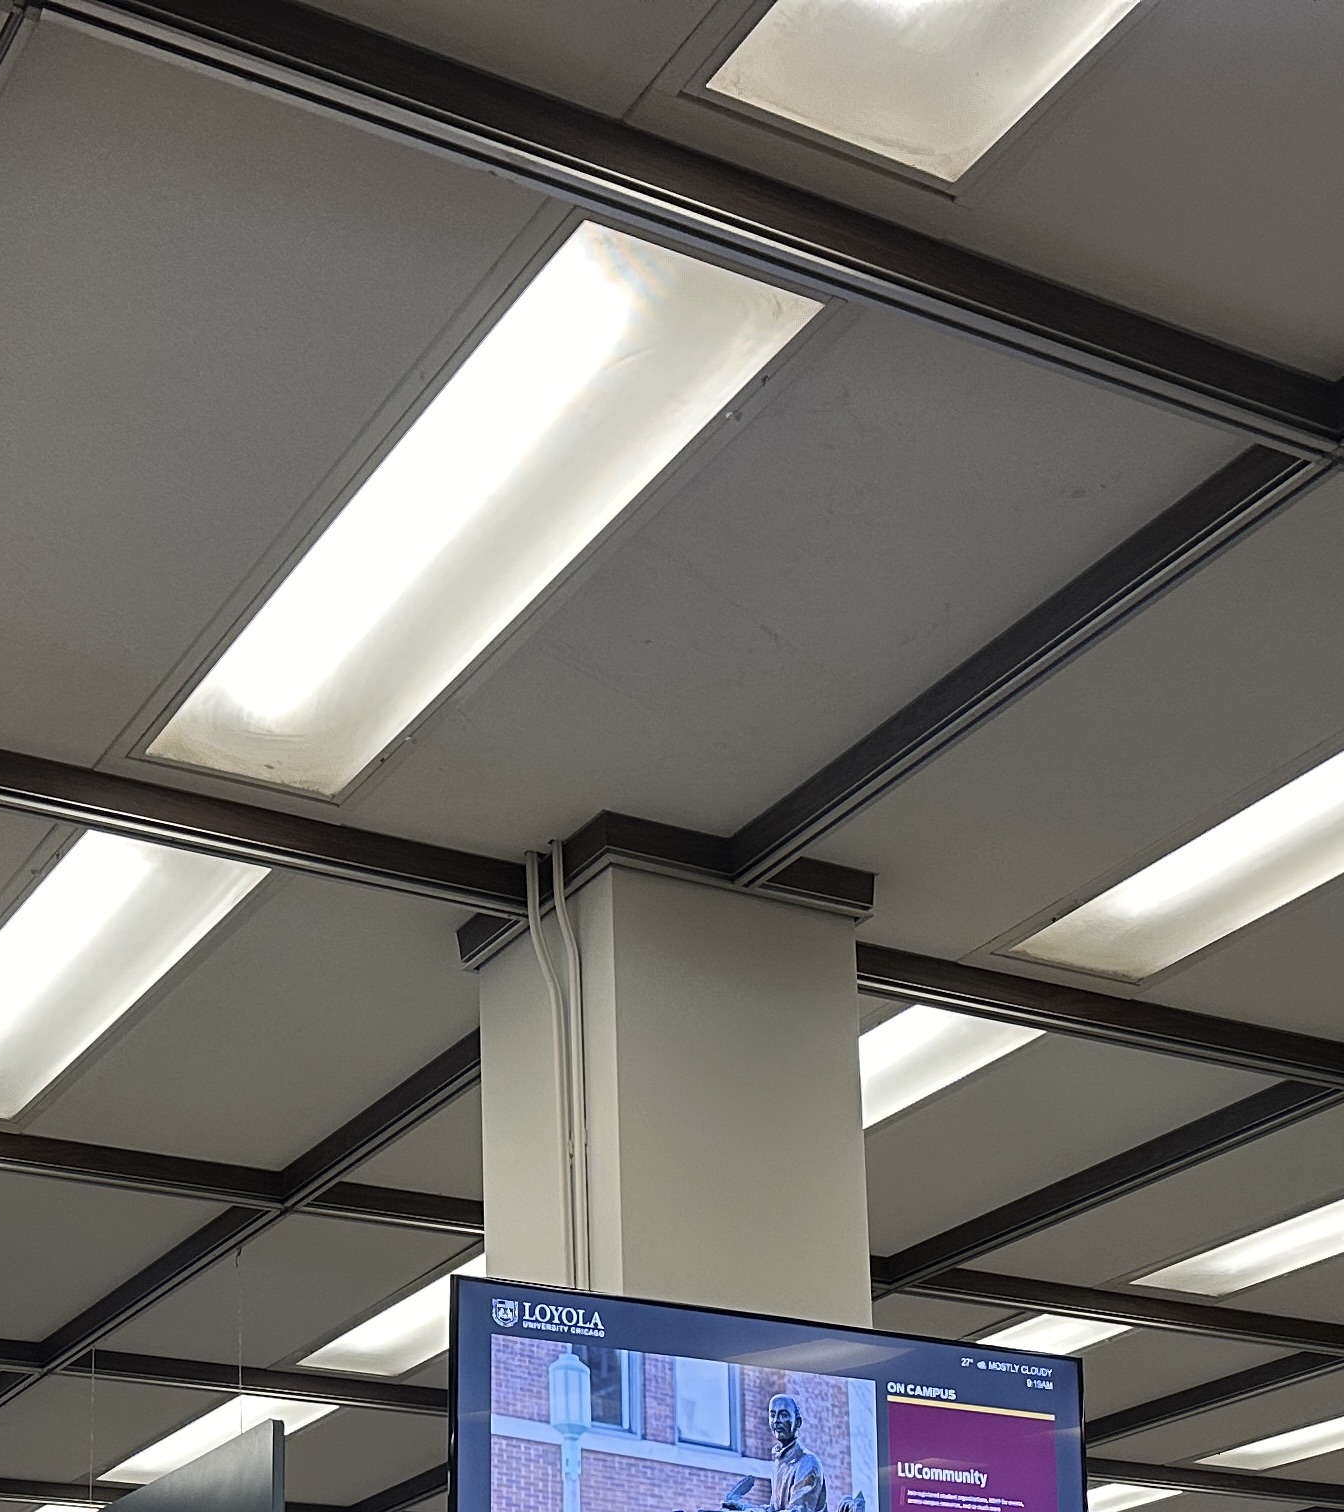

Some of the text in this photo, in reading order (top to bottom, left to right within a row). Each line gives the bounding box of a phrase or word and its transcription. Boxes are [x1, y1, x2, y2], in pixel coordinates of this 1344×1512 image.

[522, 1301, 605, 1330] LOYOLA
[522, 1320, 605, 1338] UNIVERSITY CHICAGO
[988, 1360, 1019, 1373] MOSTLY
[1020, 1365, 1053, 1377] CLOUDY
[887, 1381, 957, 1400] ON CAMPUS
[897, 1461, 988, 1488] LUCommunity
